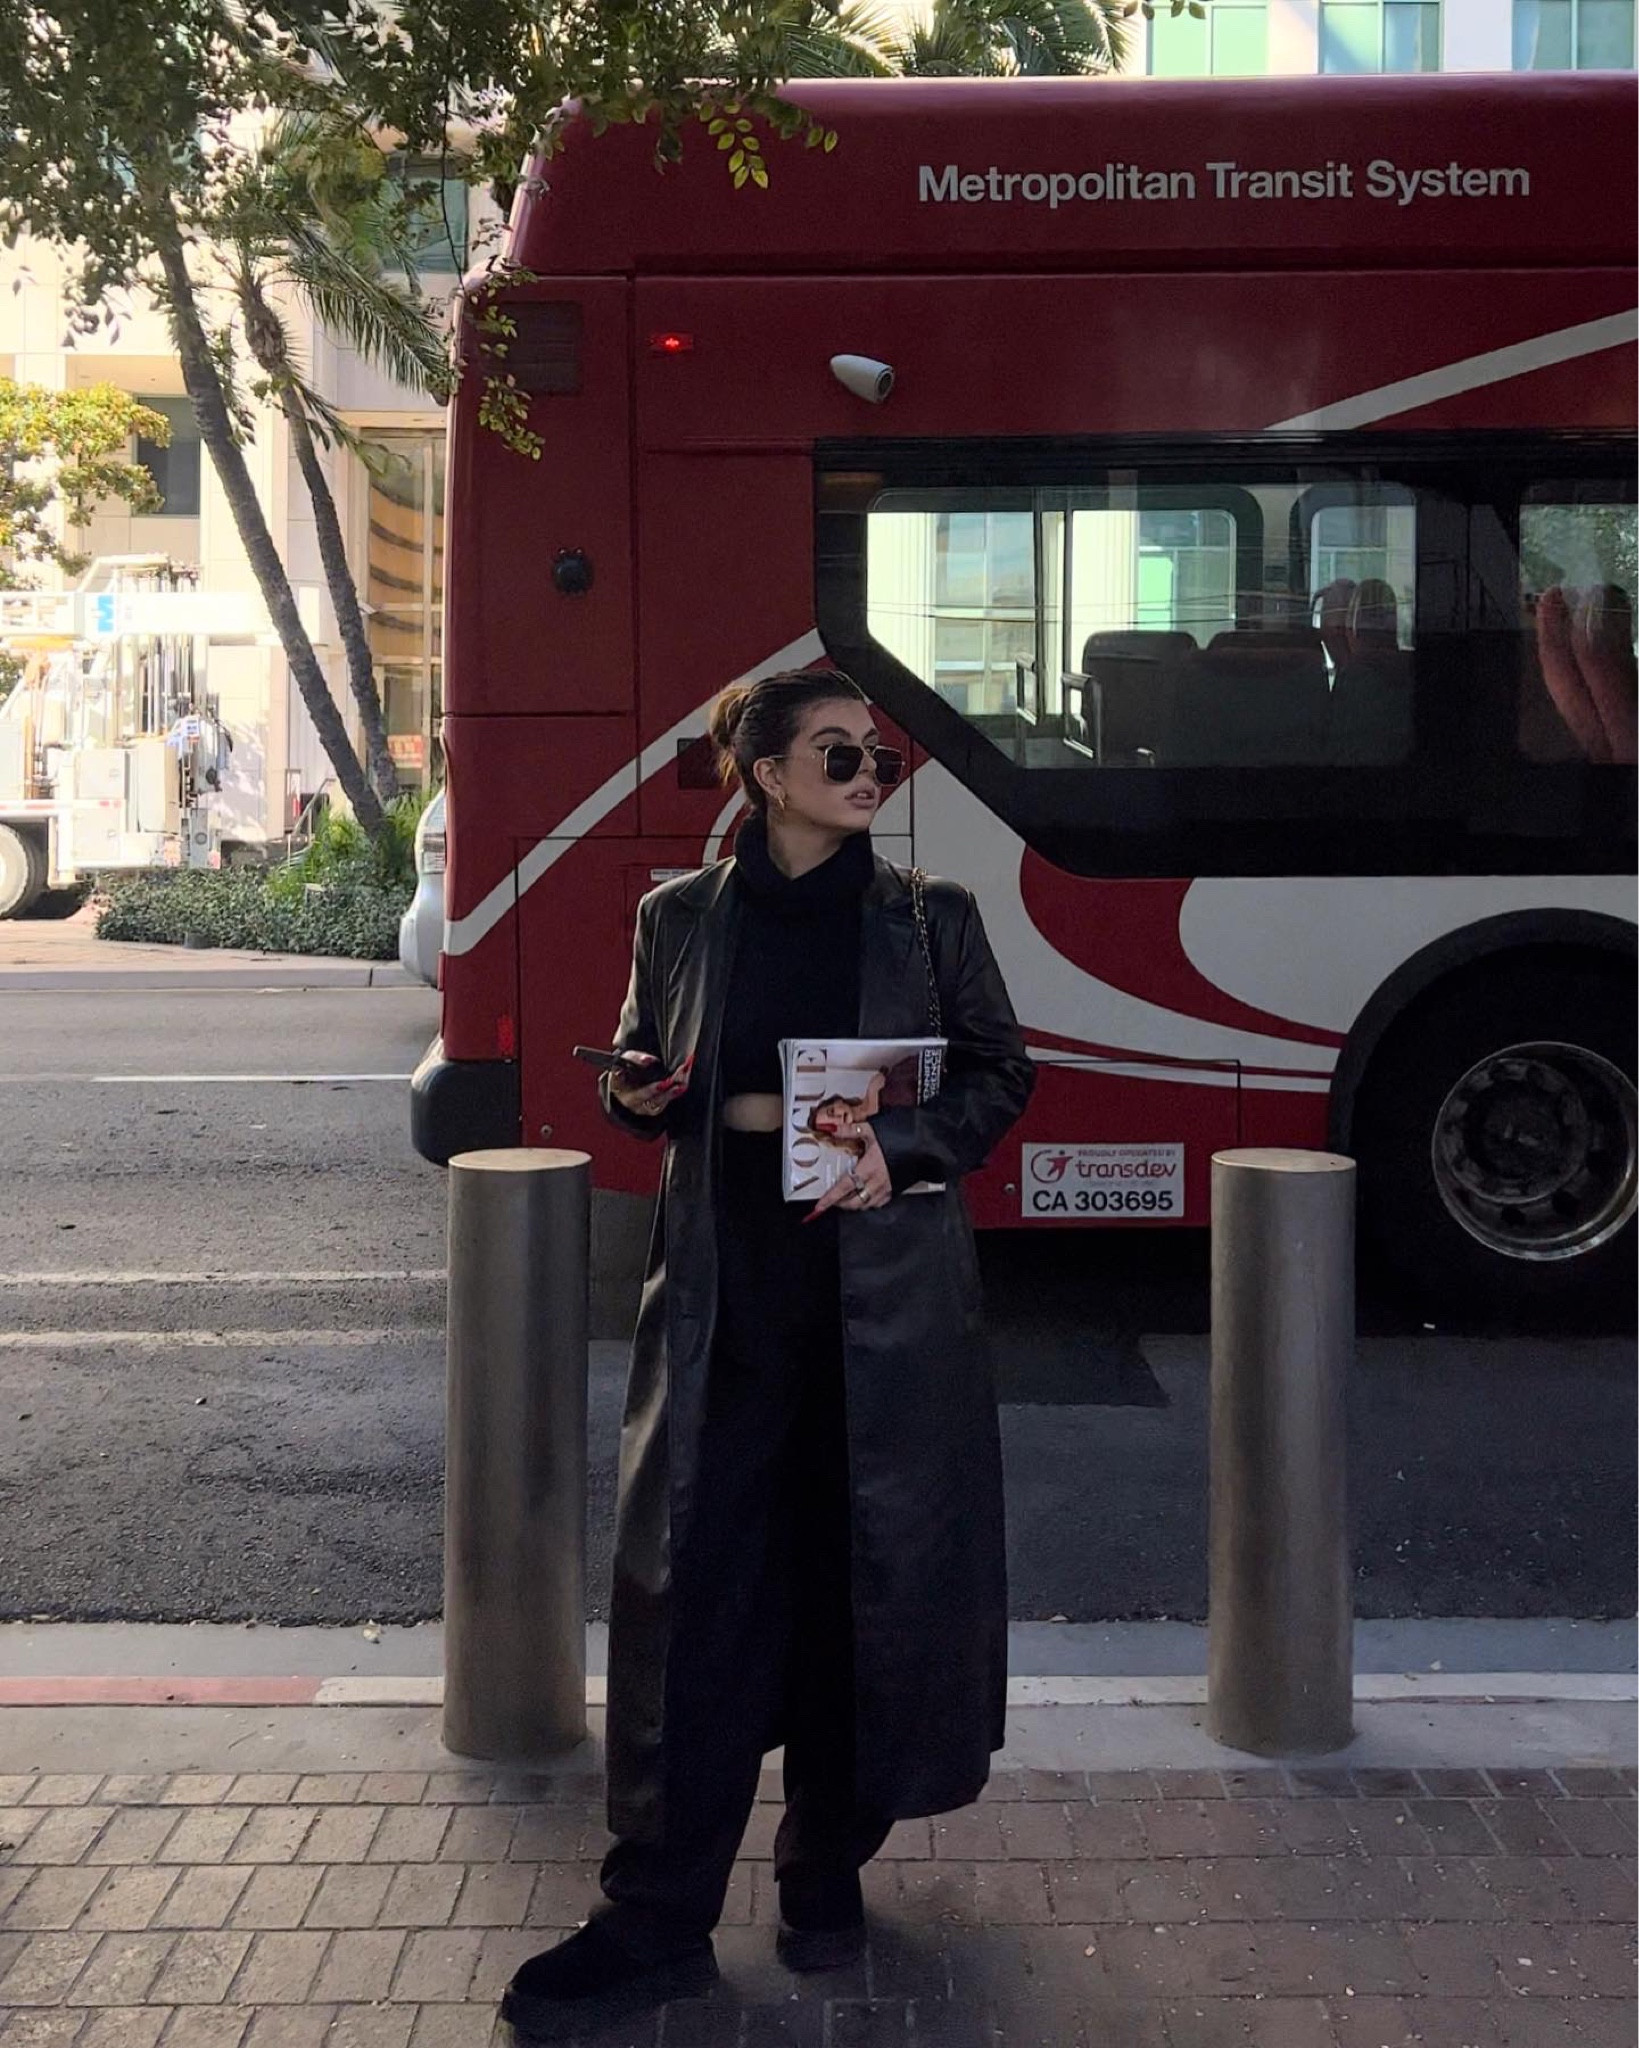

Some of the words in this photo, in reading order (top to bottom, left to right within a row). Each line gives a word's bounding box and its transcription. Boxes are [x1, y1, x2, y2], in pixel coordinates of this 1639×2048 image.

[918, 163, 1196, 208] Metropolitan
[1206, 161, 1353, 199] Transit
[1365, 159, 1531, 207] System
[791, 1049, 828, 1194] VOGUE
[1075, 1160, 1177, 1179] transdev
[1032, 1190, 1069, 1212] CA
[1074, 1190, 1174, 1212] 303695
